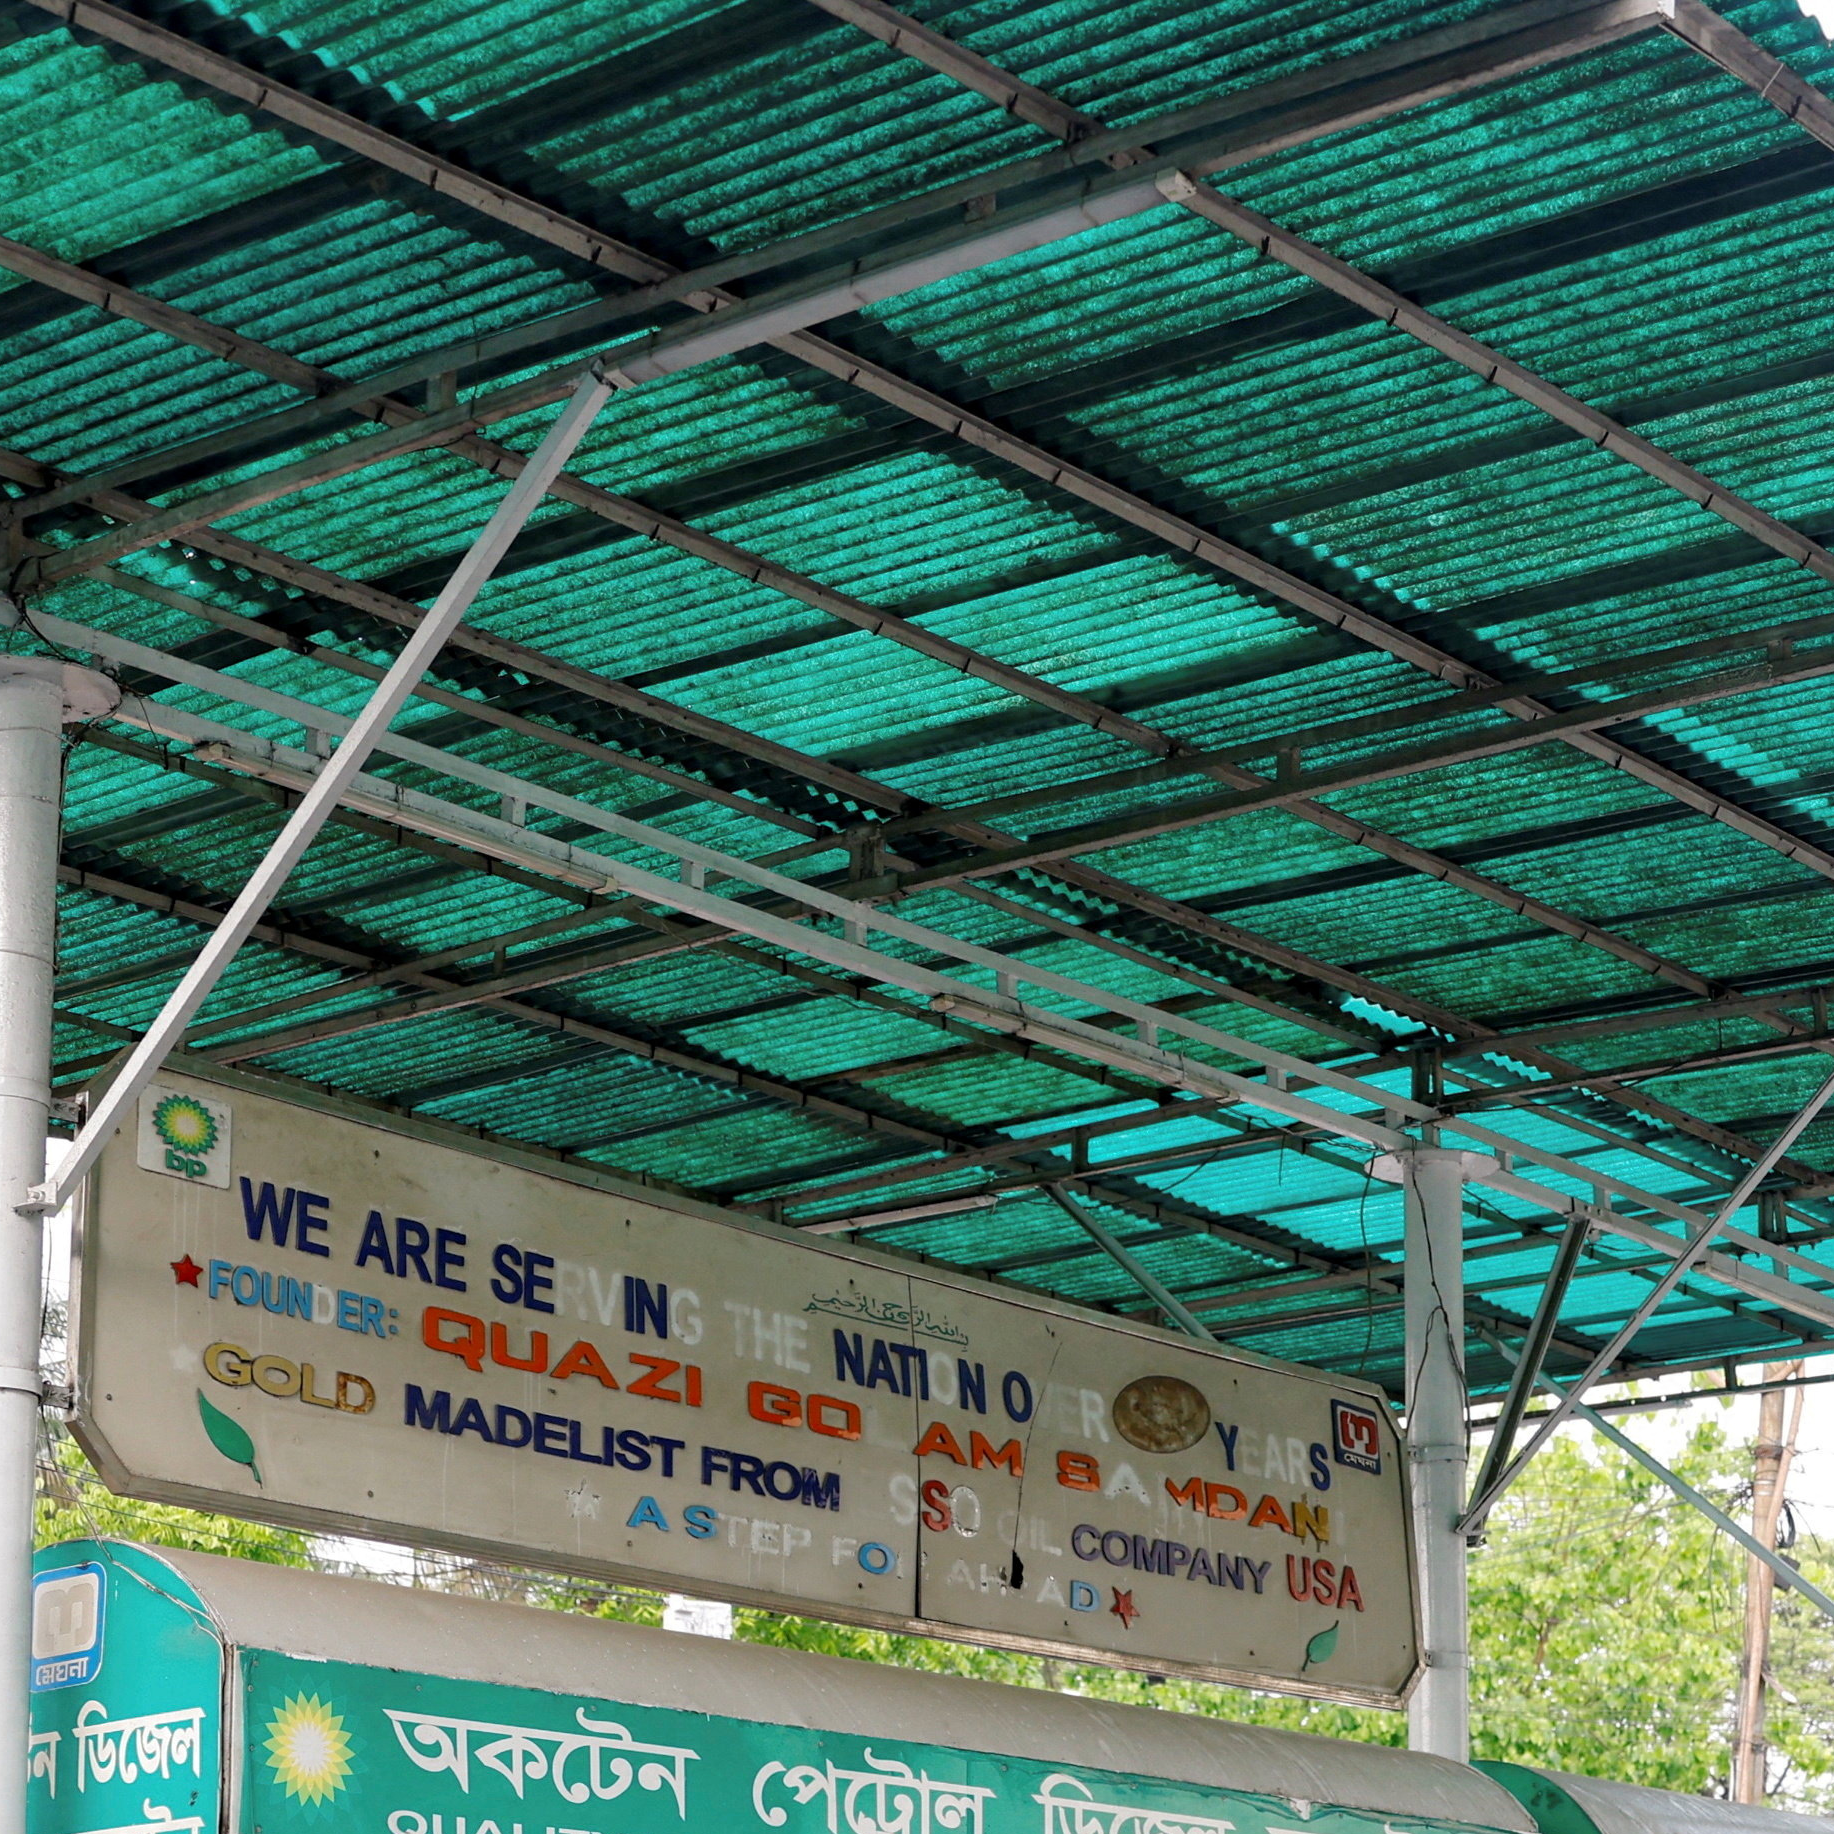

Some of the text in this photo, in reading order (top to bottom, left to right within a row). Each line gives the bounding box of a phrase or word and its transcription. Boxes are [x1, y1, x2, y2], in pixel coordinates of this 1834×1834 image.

[166, 1149, 207, 1178] bp
[209, 1259, 400, 1339] FOUNDER:
[423, 1305, 704, 1410] QUAZI
[240, 1177, 330, 1258] WE
[356, 1211, 467, 1293] ARE
[723, 1302, 812, 1375] THE
[833, 1328, 987, 1415] NATION
[1215, 1421, 1331, 1491] YEARS
[203, 1341, 376, 1416] GOLD
[404, 1383, 685, 1478] MADELIST
[701, 1445, 841, 1512] FROM
[1072, 1524, 1273, 1594] COMPANY
[1286, 1553, 1365, 1613] USA
[1343, 1452, 1378, 1472] মেঘনা
[626, 1496, 669, 1531] A
[683, 1505, 813, 1557] STEP
[35, 1655, 89, 1686] মেঘনা
[72, 1700, 206, 1793] ডিজেল
[382, 1706, 702, 1821] অকটেন
